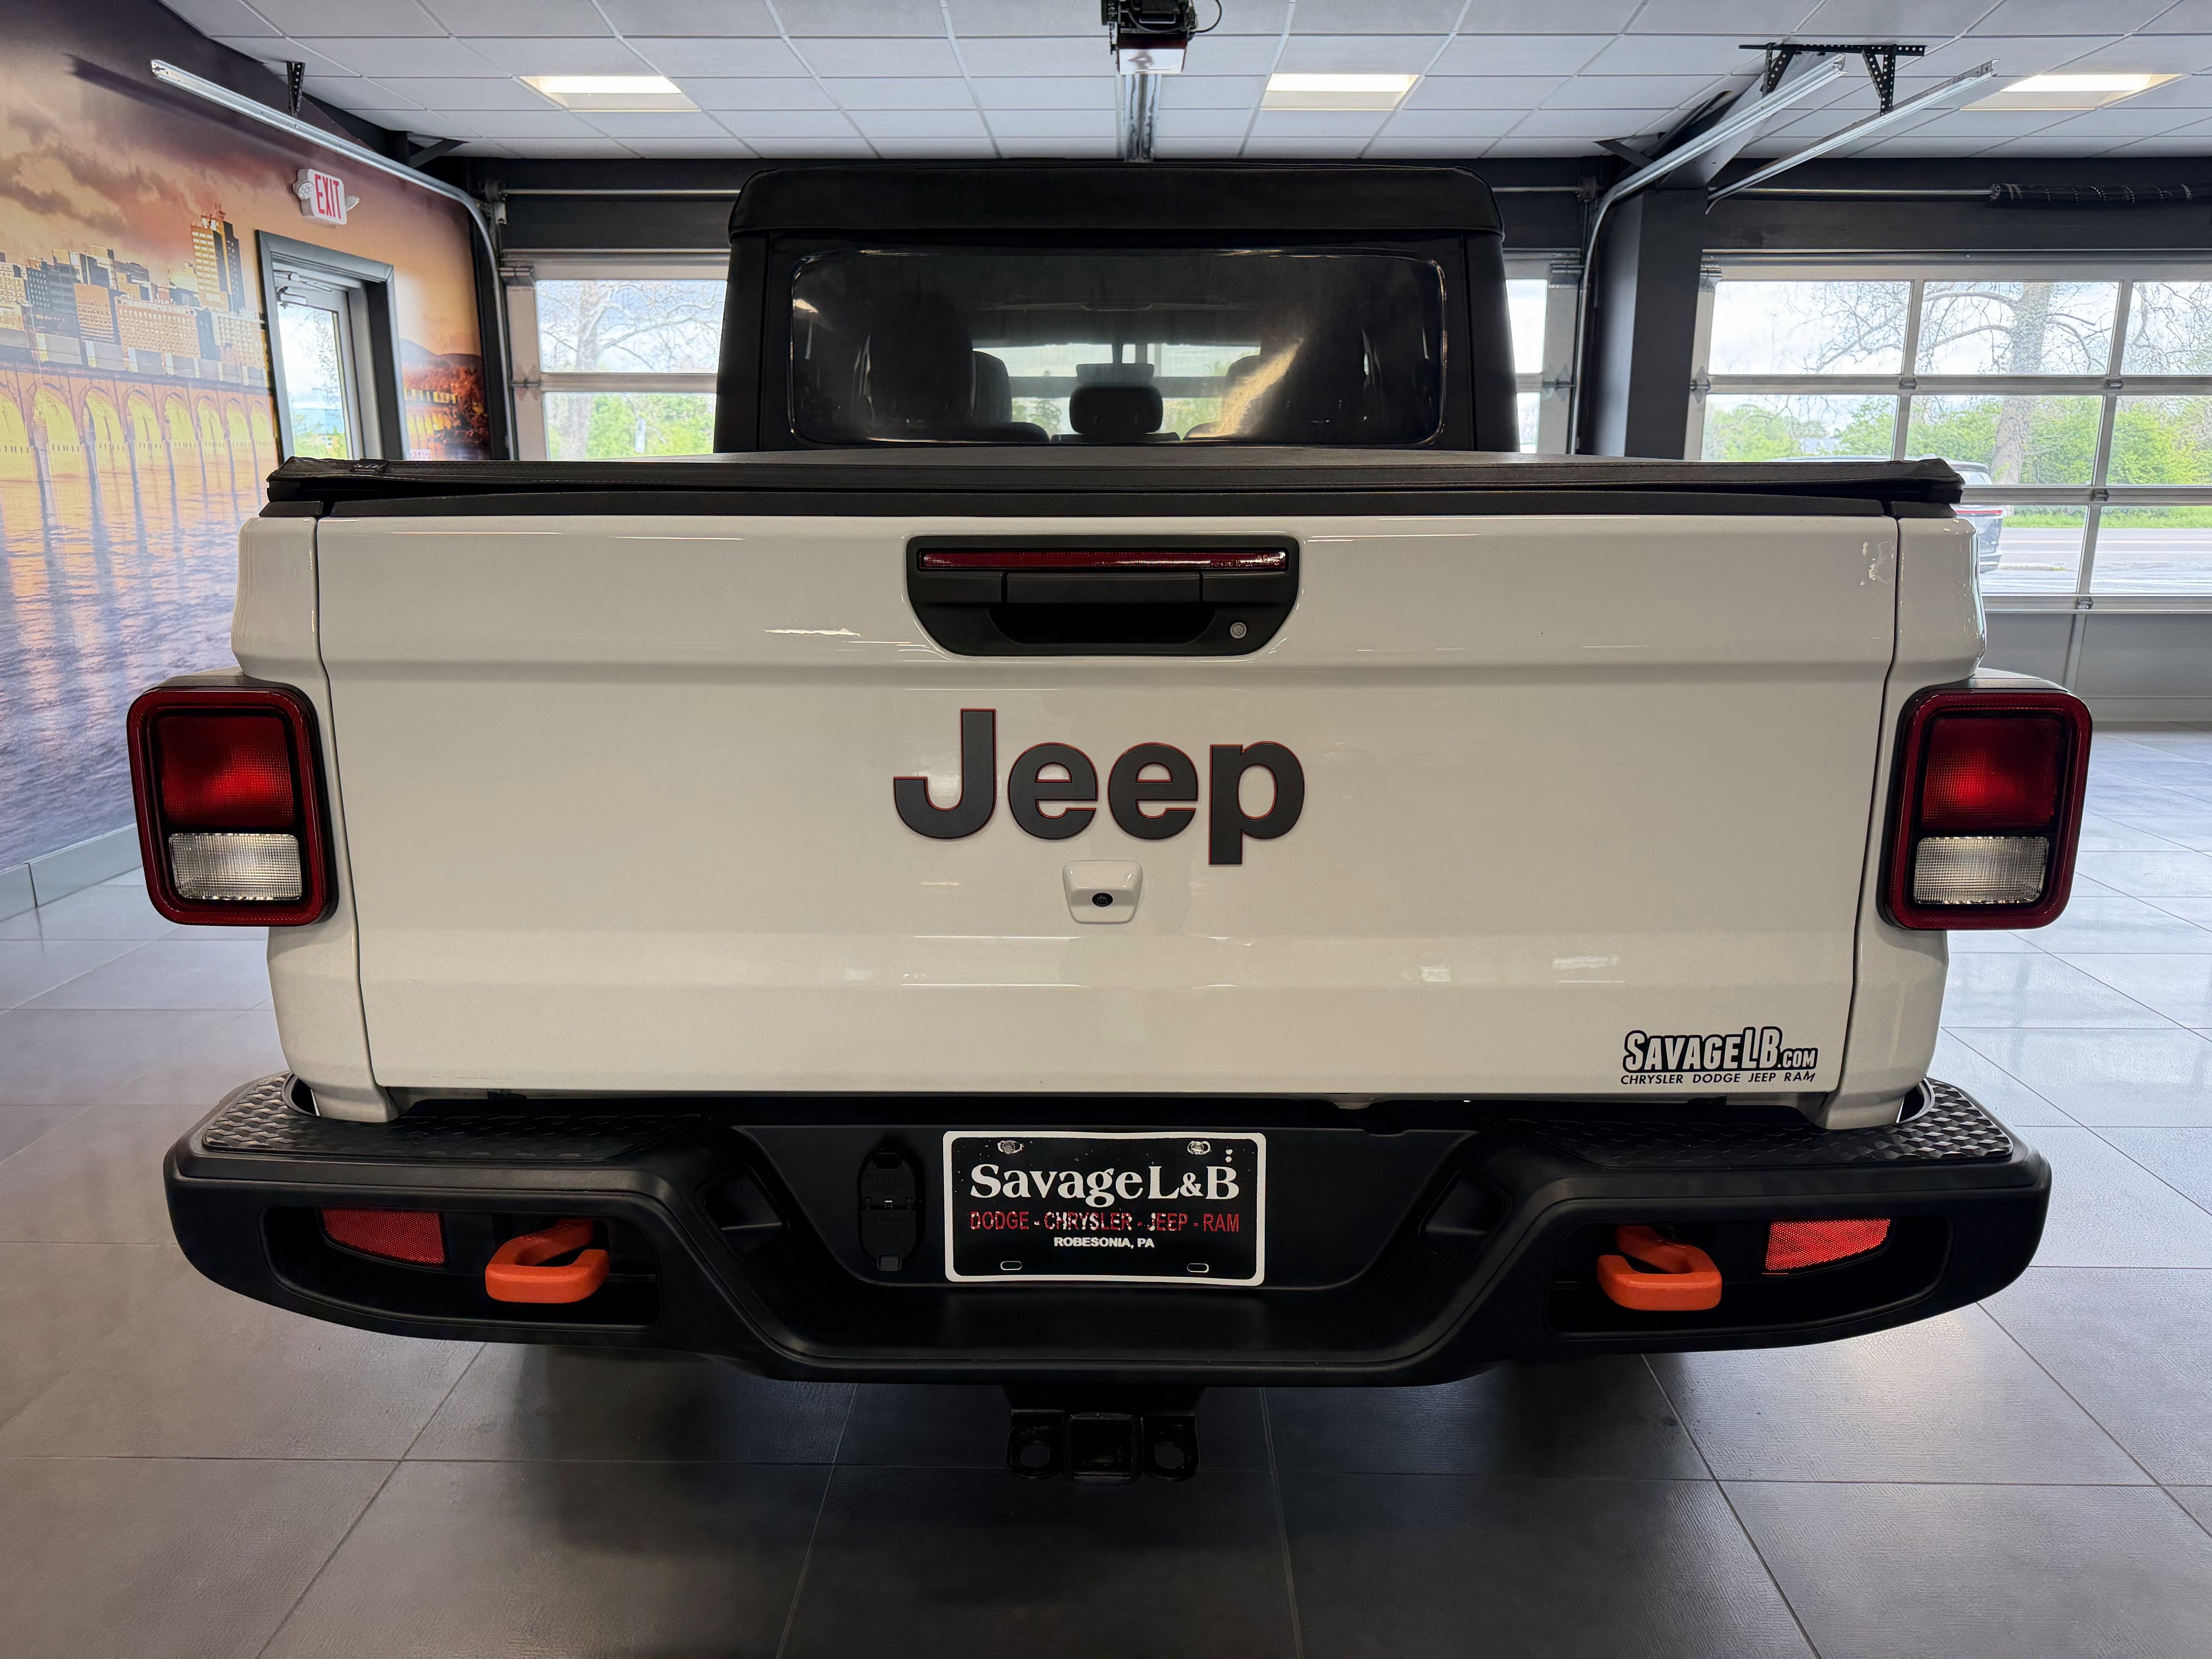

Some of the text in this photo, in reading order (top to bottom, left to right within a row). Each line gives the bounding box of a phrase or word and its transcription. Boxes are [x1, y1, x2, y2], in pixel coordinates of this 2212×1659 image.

[314, 173, 341, 219] EXIT
[893, 708, 1305, 865] Jeep
[1621, 1071, 1816, 1085] CHRYSLER DODGE JEEP RAM
[970, 1211, 1029, 1230] DODGE
[1044, 1211, 1133, 1231] CHRYSLER
[1147, 1212, 1188, 1231] JEEP
[1203, 1213, 1239, 1232] RAM
[1054, 1237, 1155, 1249] ROBESONIA, PA
